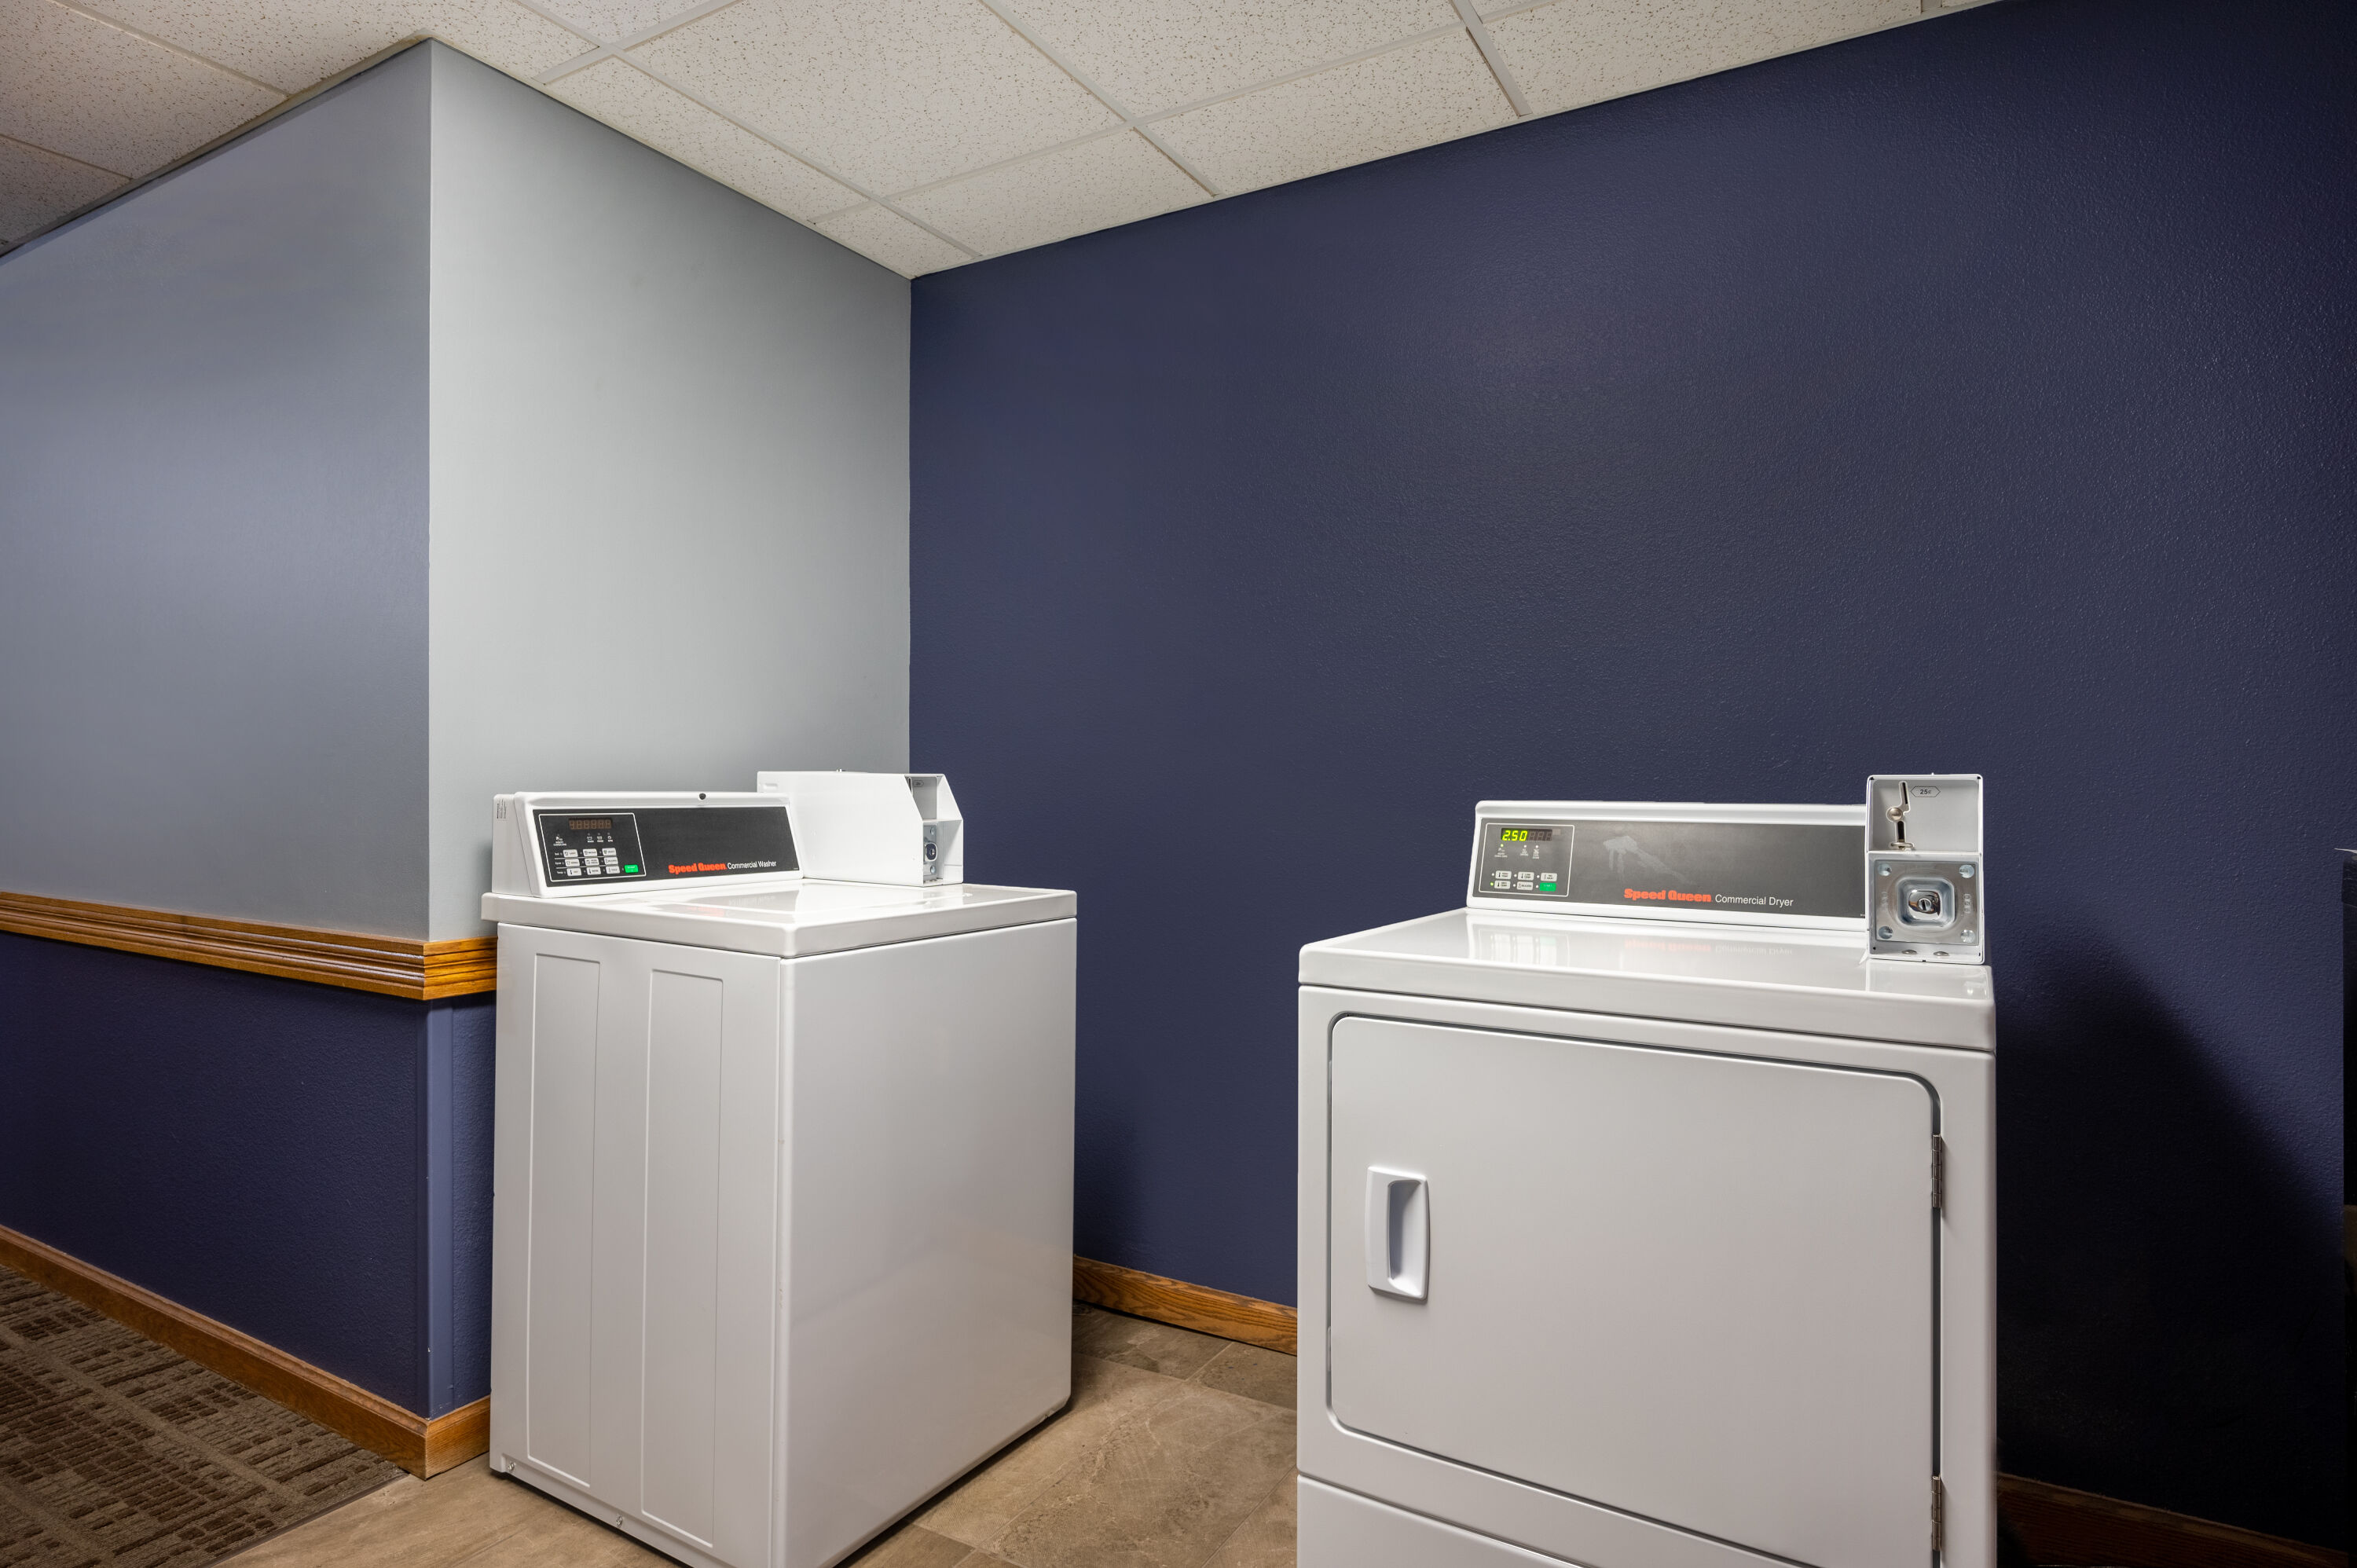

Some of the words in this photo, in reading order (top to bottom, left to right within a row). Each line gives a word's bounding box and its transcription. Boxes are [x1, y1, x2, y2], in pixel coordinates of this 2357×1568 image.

[1501, 830, 1528, 841] 2.50
[668, 863, 698, 875] Speed
[698, 862, 727, 871] Queen
[727, 861, 758, 870] Commercial
[1624, 888, 1666, 900] Speed
[1668, 890, 1711, 903] Queen
[1715, 893, 1766, 905] Commercial
[1769, 896, 1794, 908] Dryer
